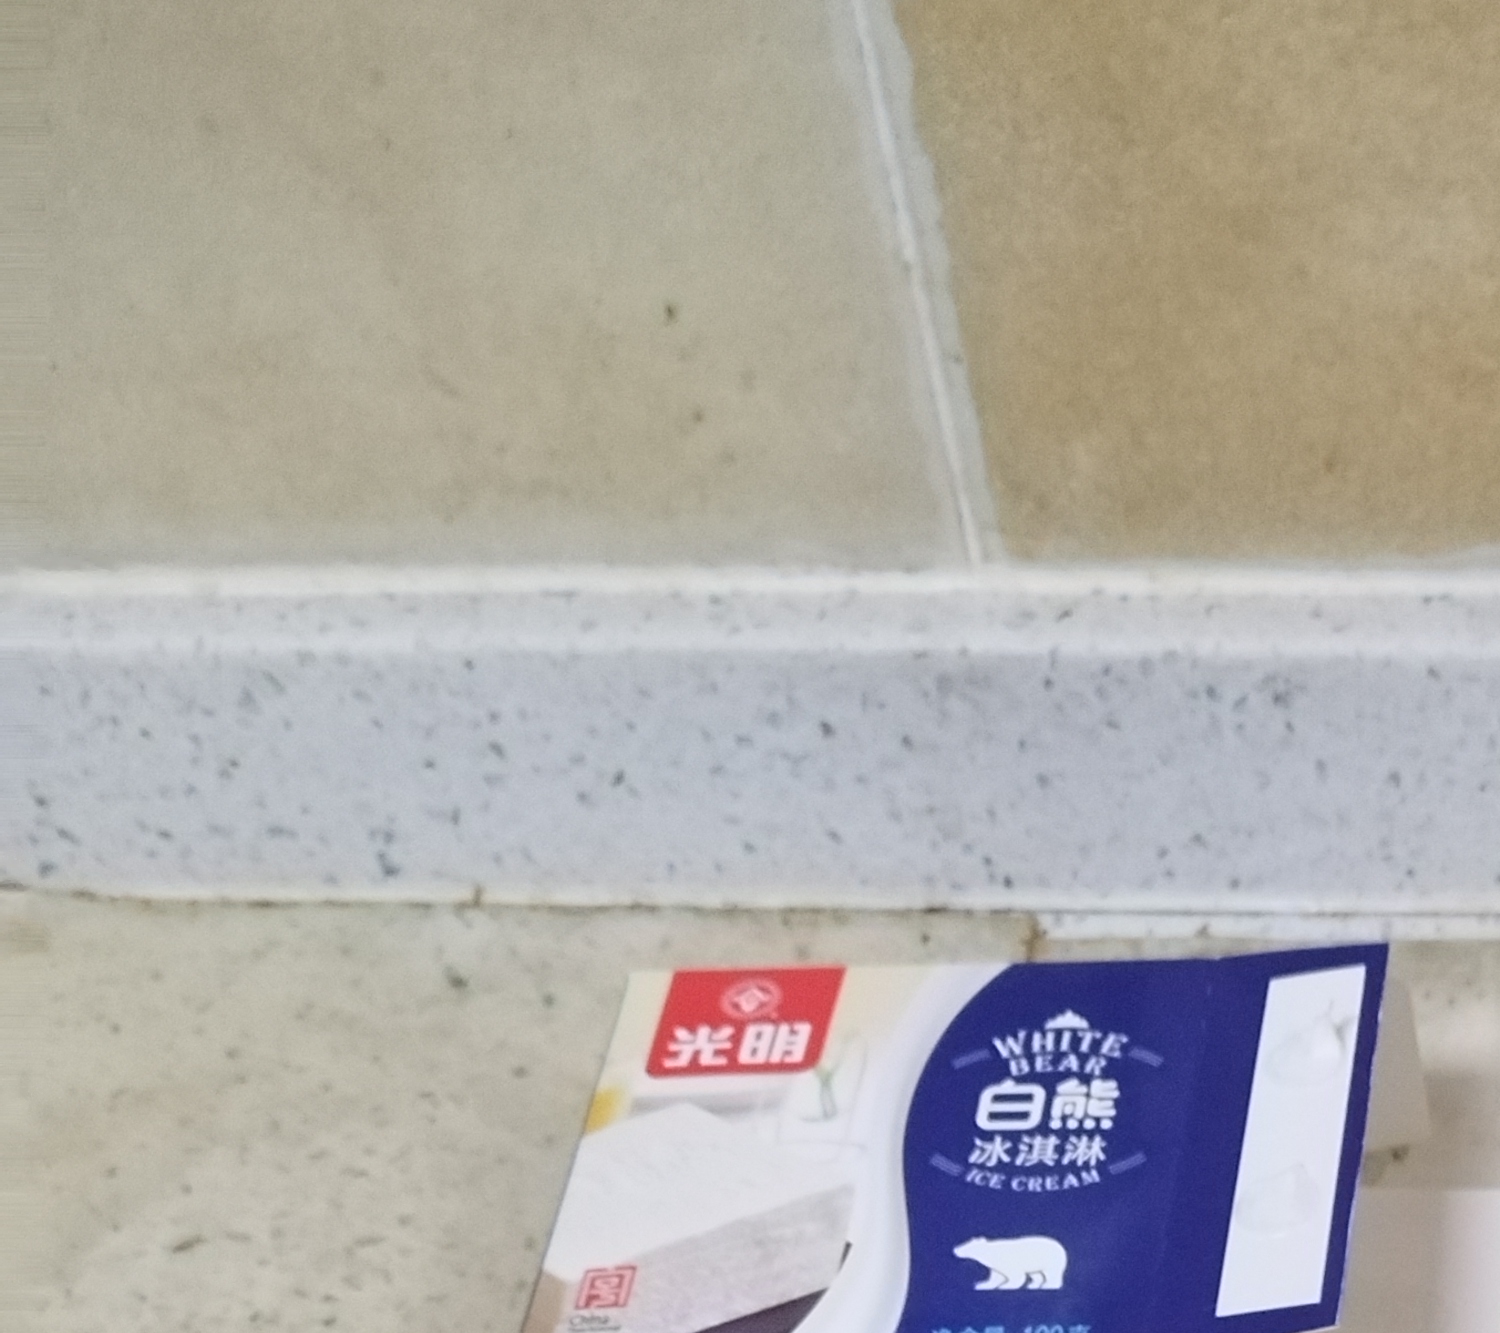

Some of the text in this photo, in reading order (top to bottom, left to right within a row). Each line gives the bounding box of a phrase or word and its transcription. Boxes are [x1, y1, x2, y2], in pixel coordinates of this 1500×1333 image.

[661, 1020, 813, 1069] 光明
[992, 1028, 1129, 1059] WHITE
[1008, 1053, 1108, 1077] BEAR
[974, 1077, 1121, 1131] 白熊
[967, 1133, 1107, 1167] 冰淇淋
[965, 1167, 1101, 1192] ICE CREAM
